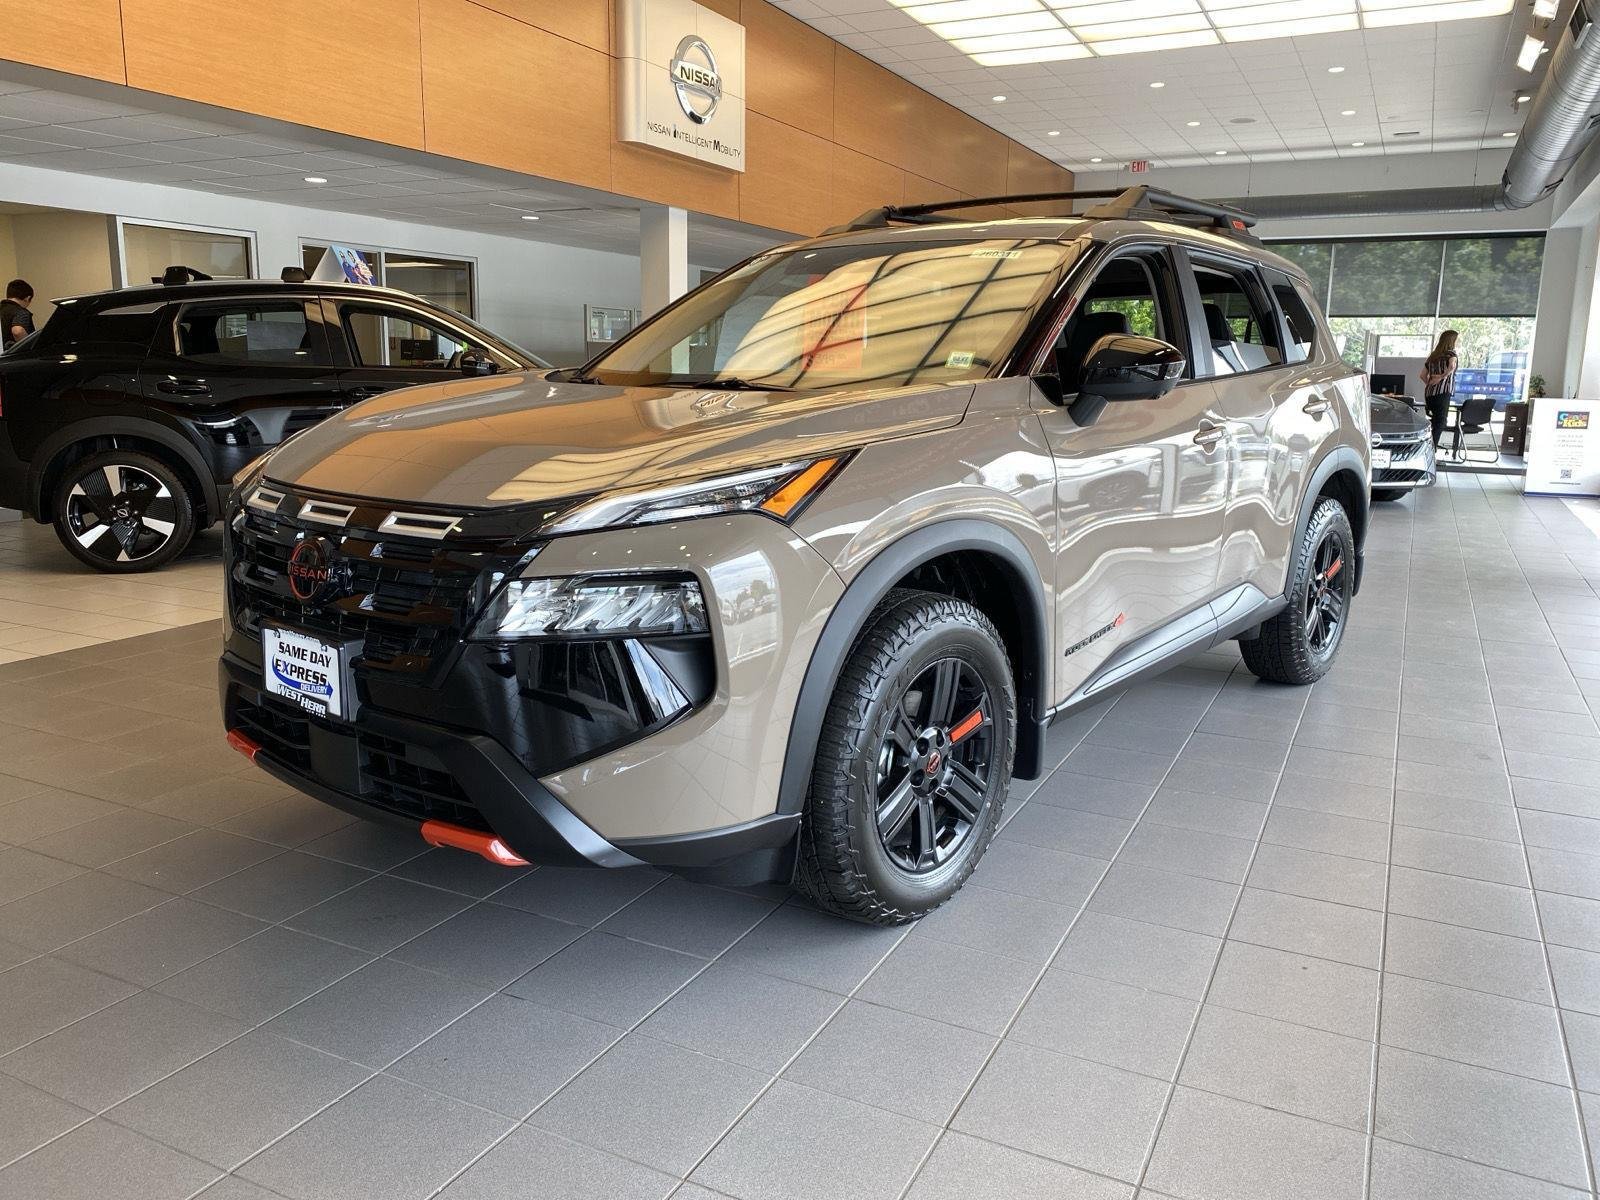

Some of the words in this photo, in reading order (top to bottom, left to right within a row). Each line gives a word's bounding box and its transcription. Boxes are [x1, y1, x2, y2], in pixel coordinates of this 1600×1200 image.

[647, 122, 671, 137] NISSAN
[673, 124, 713, 148] INTELLIGENT
[713, 139, 741, 158] MOBILITY
[1132, 161, 1147, 173] EXIT
[290, 565, 327, 580] ISSAN
[279, 641, 308, 662] SAME
[310, 651, 332, 668] DAY
[275, 658, 327, 686] EXPRESS
[277, 684, 303, 702] WEST
[301, 697, 326, 715] HERR
[300, 682, 328, 694] DELIVERY
